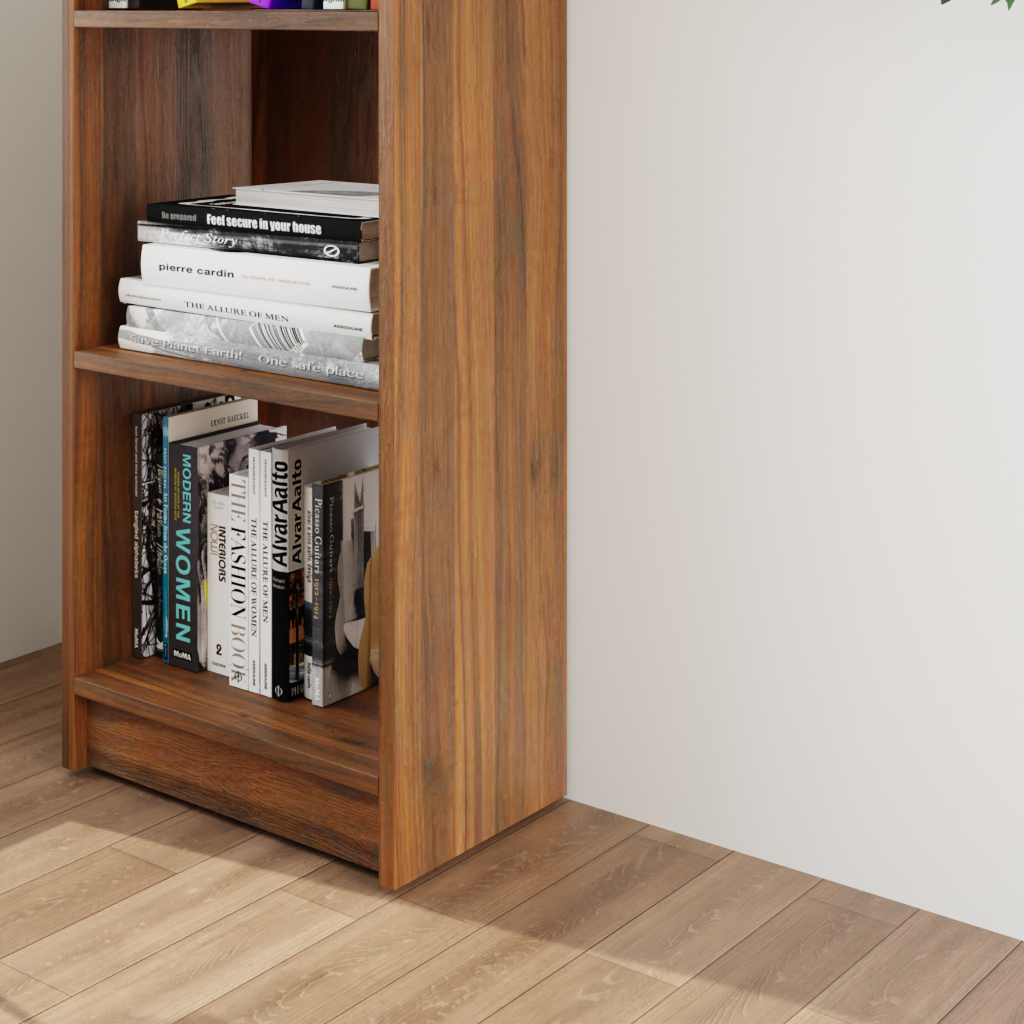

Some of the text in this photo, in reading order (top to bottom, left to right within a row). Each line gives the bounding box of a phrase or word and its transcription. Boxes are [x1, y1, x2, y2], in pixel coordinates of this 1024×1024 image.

[161, 211, 197, 222] Be prepared
[206, 213, 322, 235] Feel secure in your house
[159, 228, 238, 249] Perfect Story
[159, 263, 235, 278] pierre cardin
[184, 300, 289, 322] THE ALLURE OF MEN
[333, 324, 364, 332] ASSOULINE
[130, 335, 366, 380] Save Planet Earth! One safe place
[210, 416, 226, 427] ERNST
[272, 461, 288, 567] Alvar Aalto
[292, 459, 302, 564] Alvar Aalto
[314, 498, 322, 534] Picasso
[175, 453, 192, 644] MODERN WOMEN
[210, 523, 219, 557] NOW!
[218, 525, 227, 583] INTERIORS
[314, 535, 322, 574] Guitars
[230, 479, 247, 684] THE FASHION BOOK
[251, 581, 257, 596] OF
[262, 584, 269, 598] OF
[173, 649, 192, 662] MoMA
[216, 644, 222, 656] 2
